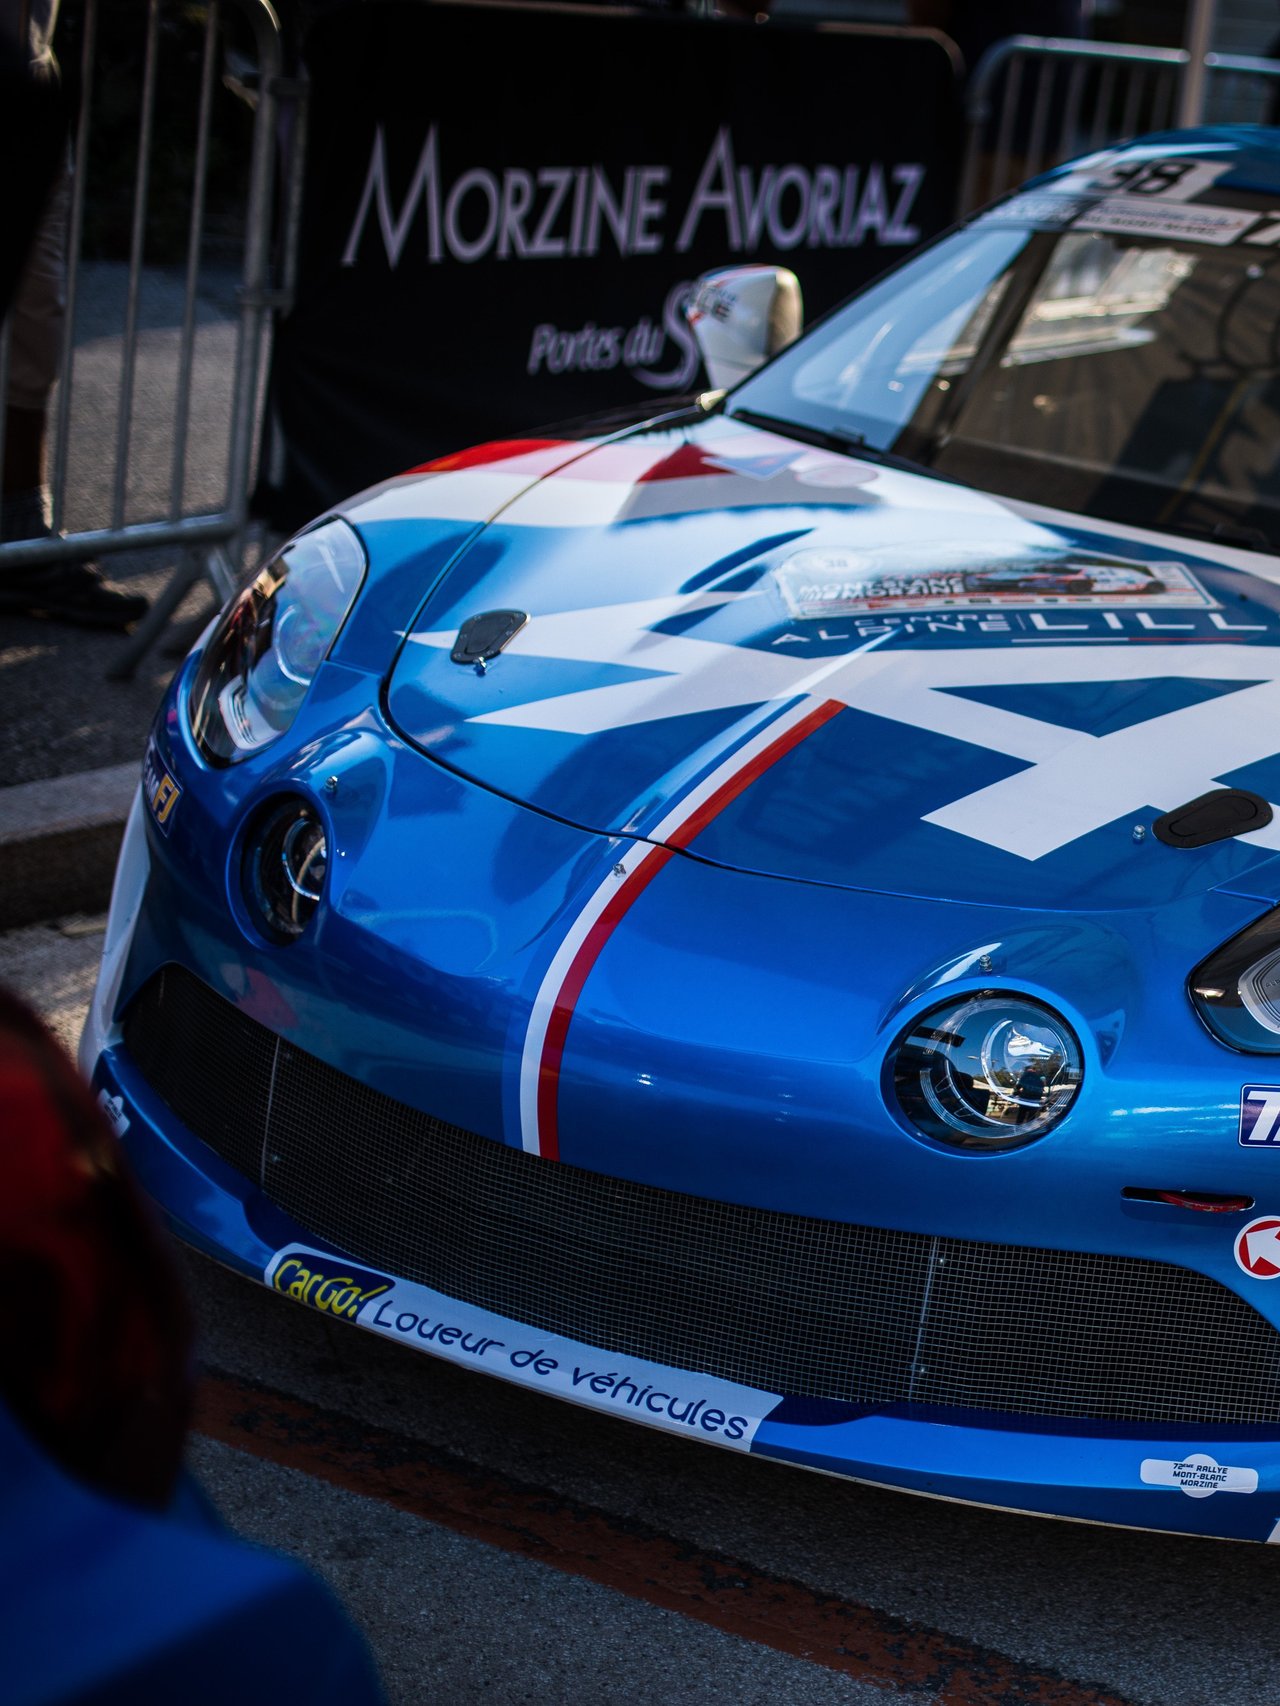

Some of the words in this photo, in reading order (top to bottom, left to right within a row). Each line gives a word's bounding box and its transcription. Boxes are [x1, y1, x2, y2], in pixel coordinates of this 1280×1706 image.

[341, 120, 672, 271] MORZINE
[677, 122, 925, 253] AVORIAZ
[526, 319, 624, 377] Portes
[623, 315, 666, 368] du
[854, 613, 1006, 627] CENTRE
[771, 620, 1012, 647] ALPINE
[372, 1300, 507, 1357] Loueur
[509, 1348, 560, 1377] de
[571, 1366, 751, 1441] véhicules
[1172, 1470, 1228, 1483] MONT-BLANC
[1196, 1465, 1229, 1475] RALLYE
[1180, 1478, 1219, 1489] MORZINE
